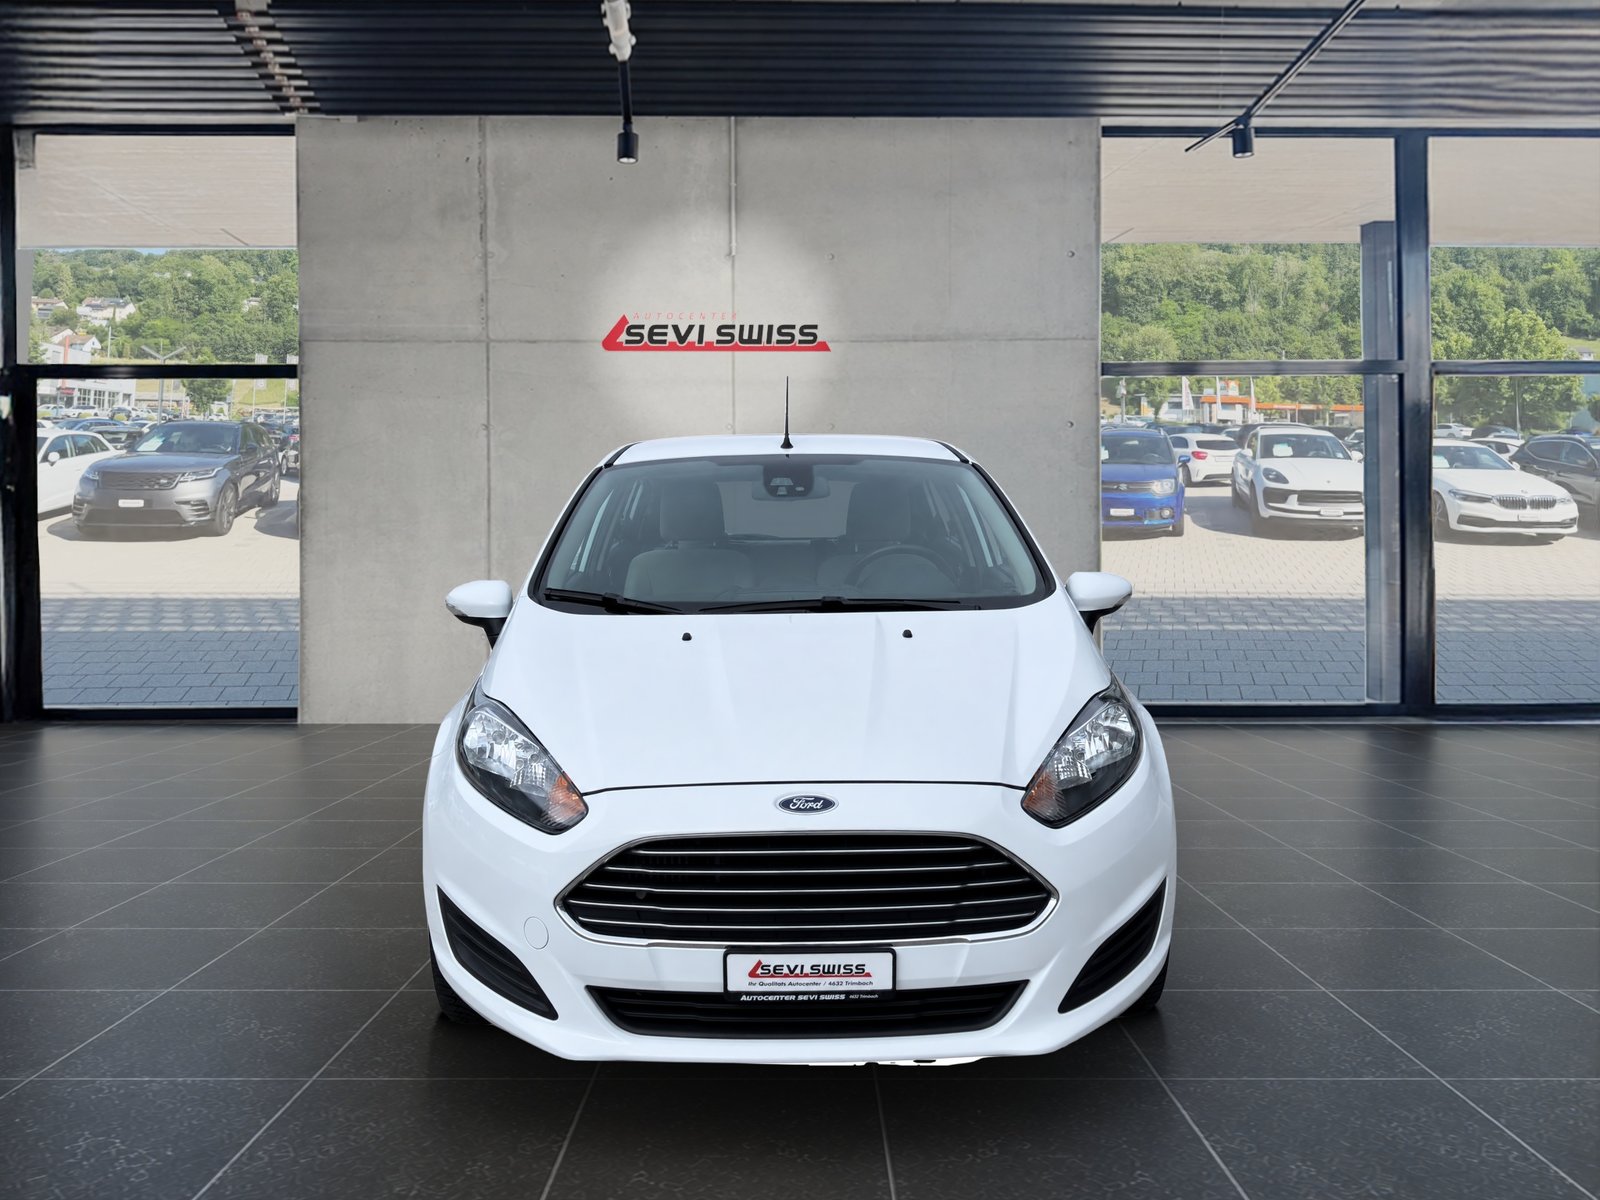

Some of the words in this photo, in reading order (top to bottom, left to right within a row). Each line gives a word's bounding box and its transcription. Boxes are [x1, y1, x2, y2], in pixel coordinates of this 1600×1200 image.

[633, 312, 737, 321] AUTOCENTER
[624, 324, 706, 345] SEVI
[715, 324, 819, 345] SWISS
[789, 797, 824, 809] Ford
[760, 964, 805, 975] SEVI
[809, 963, 866, 975] SWISS
